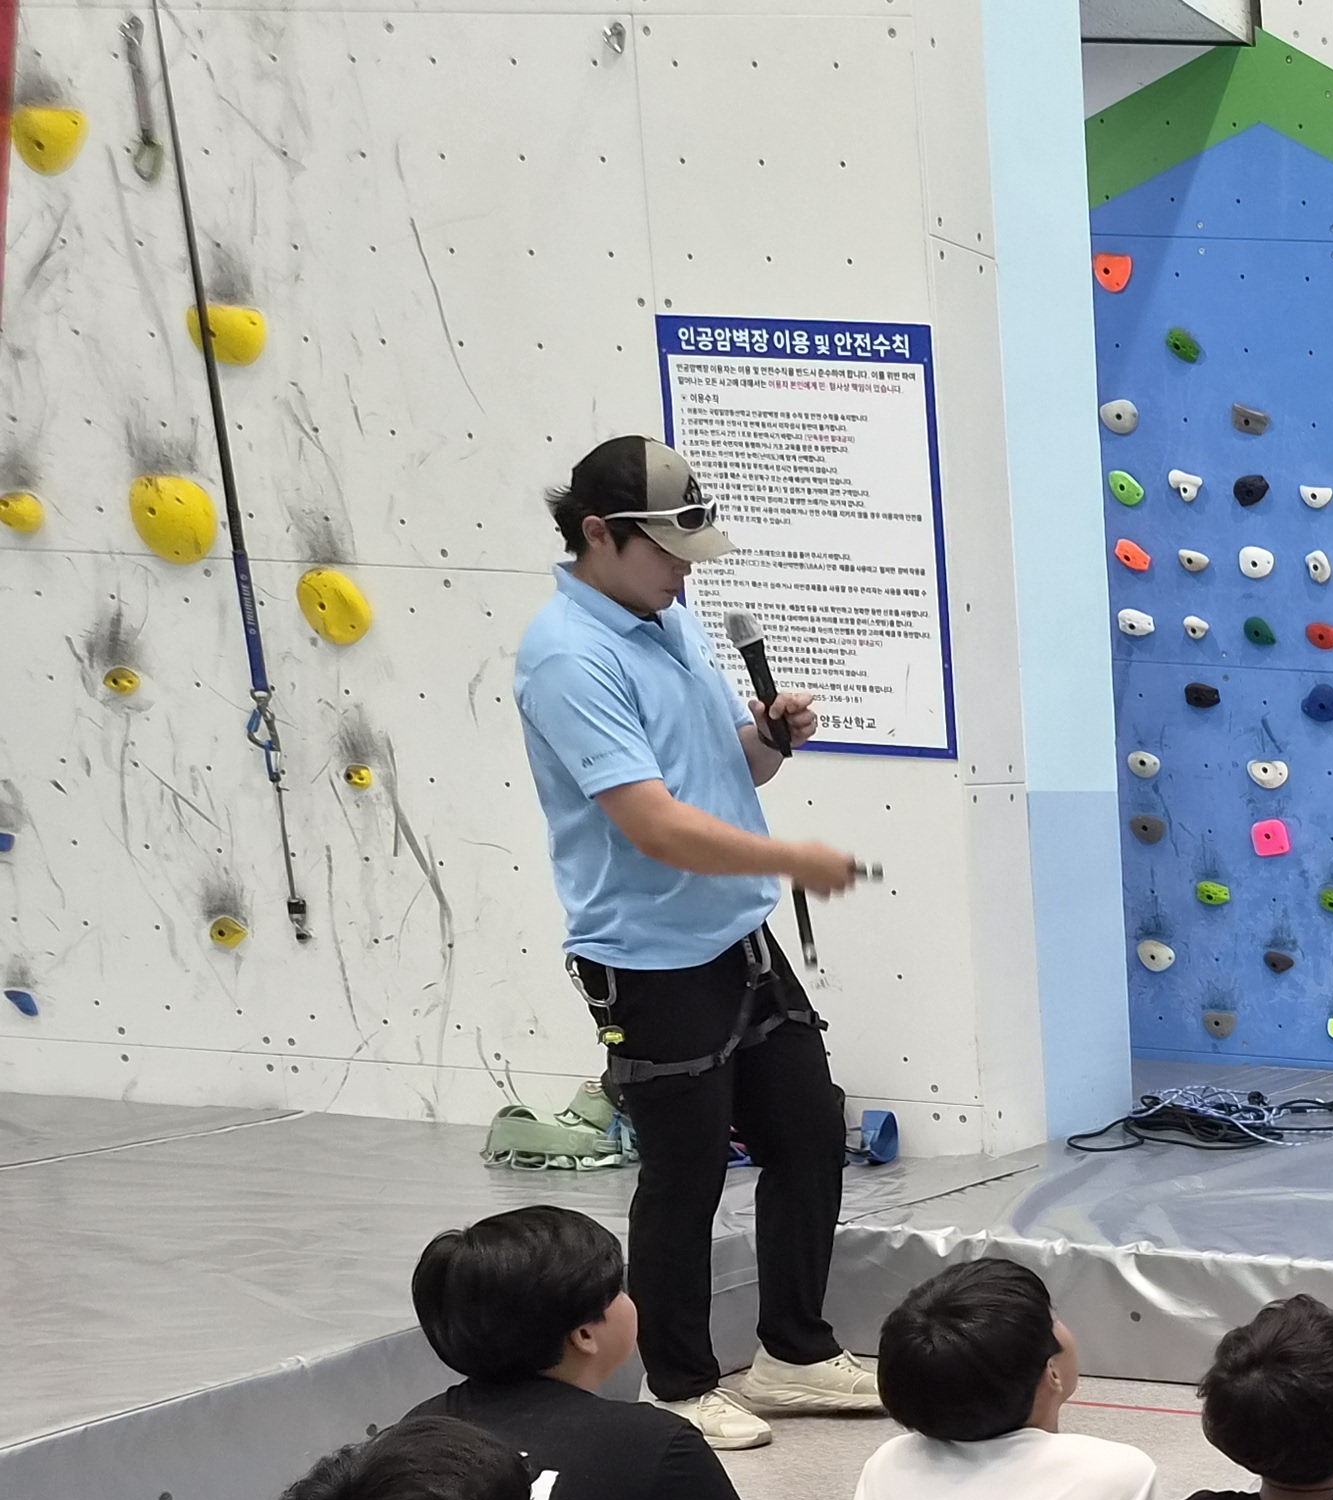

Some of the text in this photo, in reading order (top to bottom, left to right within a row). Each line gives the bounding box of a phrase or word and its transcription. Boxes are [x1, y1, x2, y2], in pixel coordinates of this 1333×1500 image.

[677, 326, 911, 358] 인공암벽장 이용 및 안전수칙
[814, 713, 877, 730] 양등산학교
